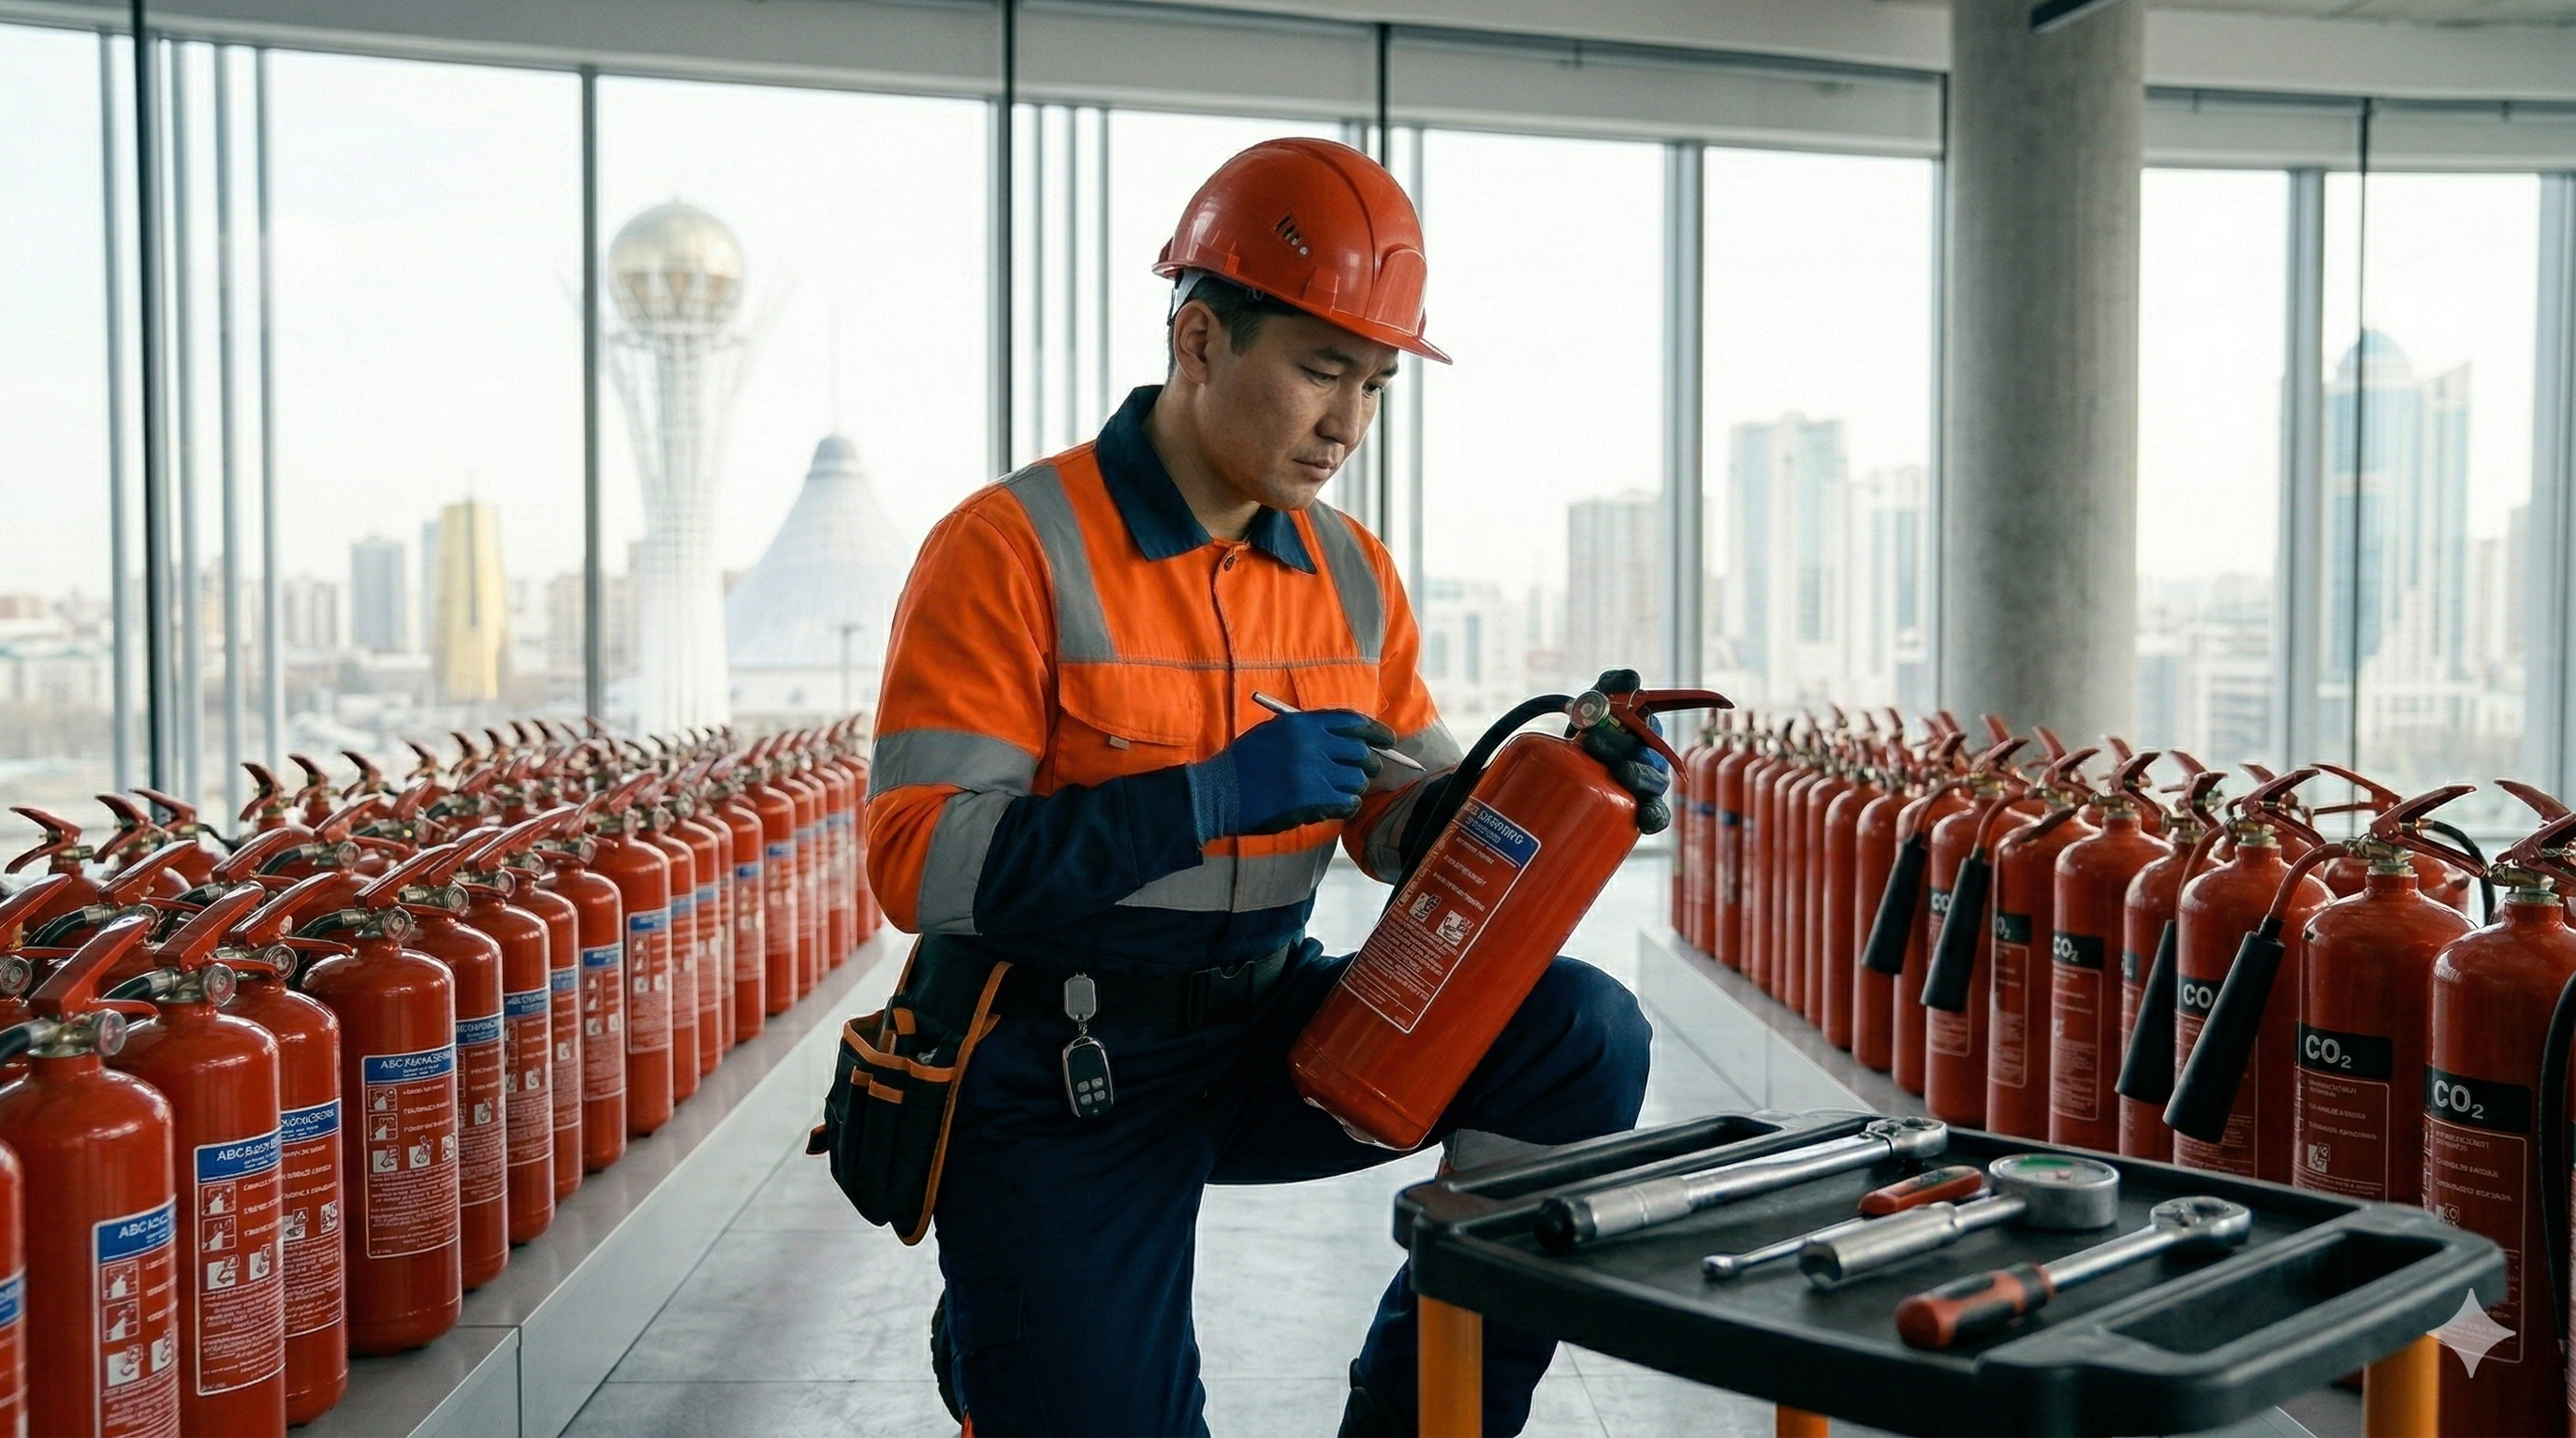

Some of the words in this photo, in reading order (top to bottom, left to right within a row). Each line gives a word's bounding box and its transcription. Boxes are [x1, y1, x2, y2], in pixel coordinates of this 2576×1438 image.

[1931, 892, 1951, 912] CO
[2183, 983, 2213, 1009] CO
[118, 1220, 146, 1239] ABC
